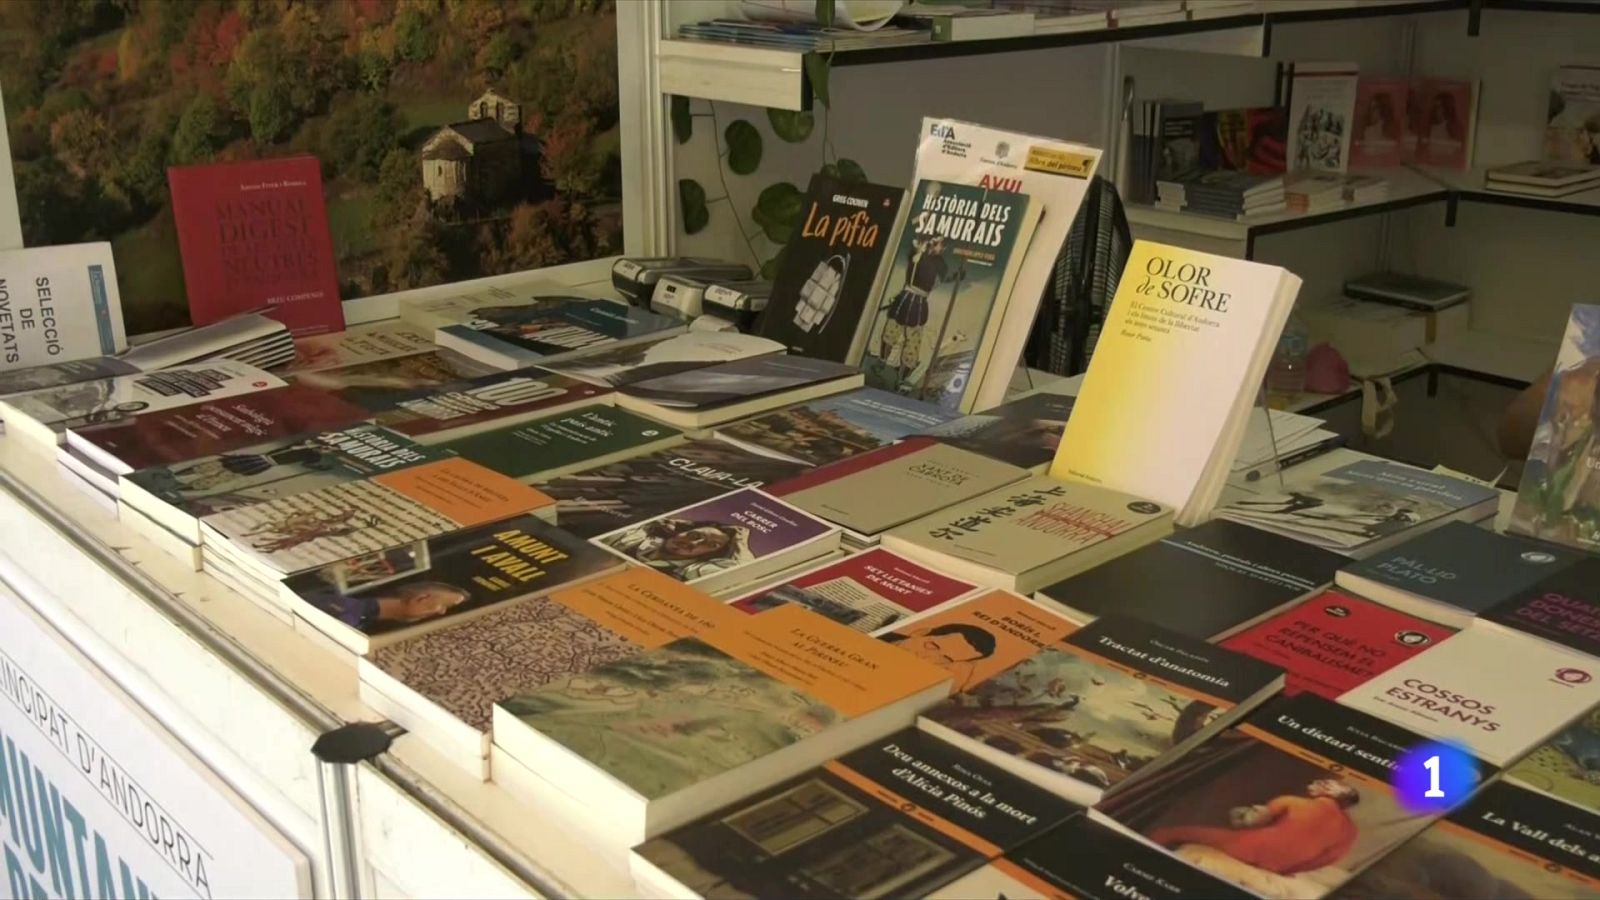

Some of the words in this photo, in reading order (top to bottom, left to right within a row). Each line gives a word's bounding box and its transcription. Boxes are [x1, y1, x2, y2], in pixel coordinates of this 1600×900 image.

[802, 201, 830, 238] La
[923, 194, 979, 217] HISTÒRIA
[979, 202, 1011, 223] DELS
[219, 216, 312, 241] DIGEST
[915, 212, 1005, 247] SAMURAIS
[1146, 256, 1211, 287] OLOR
[1136, 277, 1155, 296] de
[1156, 281, 1232, 313] SOFRE
[20, 308, 35, 331] DE
[36, 277, 63, 356] SELECCIÓ
[1160, 308, 1187, 320] Cultural
[317, 432, 406, 468] SAMURAIS
[390, 448, 426, 462] DELS
[668, 457, 765, 489] CLAVA-LA
[730, 512, 748, 523] DEL
[746, 520, 772, 534] BOSC
[744, 510, 778, 529] CARRER
[471, 545, 498, 555] I
[493, 529, 569, 564] AMUNT
[481, 551, 546, 582] AVALL
[863, 565, 884, 575] SET
[882, 573, 934, 595] LLETANIES
[865, 574, 882, 584] DE
[880, 581, 912, 595] MORT
[1280, 627, 1358, 659] REPENSEM
[1293, 620, 1320, 633] PER
[1358, 644, 1386, 658] NO
[1099, 635, 1148, 660] Tractat
[1148, 656, 1230, 688] d'anatomia
[1385, 687, 1502, 733] ESTRANYS
[1402, 678, 1497, 715] COSSOS
[1277, 714, 1301, 729] Un
[1301, 726, 1357, 753] dietari
[0, 656, 70, 755] INCIPAT
[77, 731, 213, 897] D'ANDORRA
[882, 743, 913, 763] Deu
[911, 759, 971, 793] annexos
[968, 787, 980, 797] a
[979, 792, 996, 805] la
[995, 800, 1039, 825] mort
[943, 793, 988, 820] Pinós
[1481, 812, 1506, 826] La
[1512, 821, 1549, 841] Vall
[1548, 838, 1587, 857] dels
